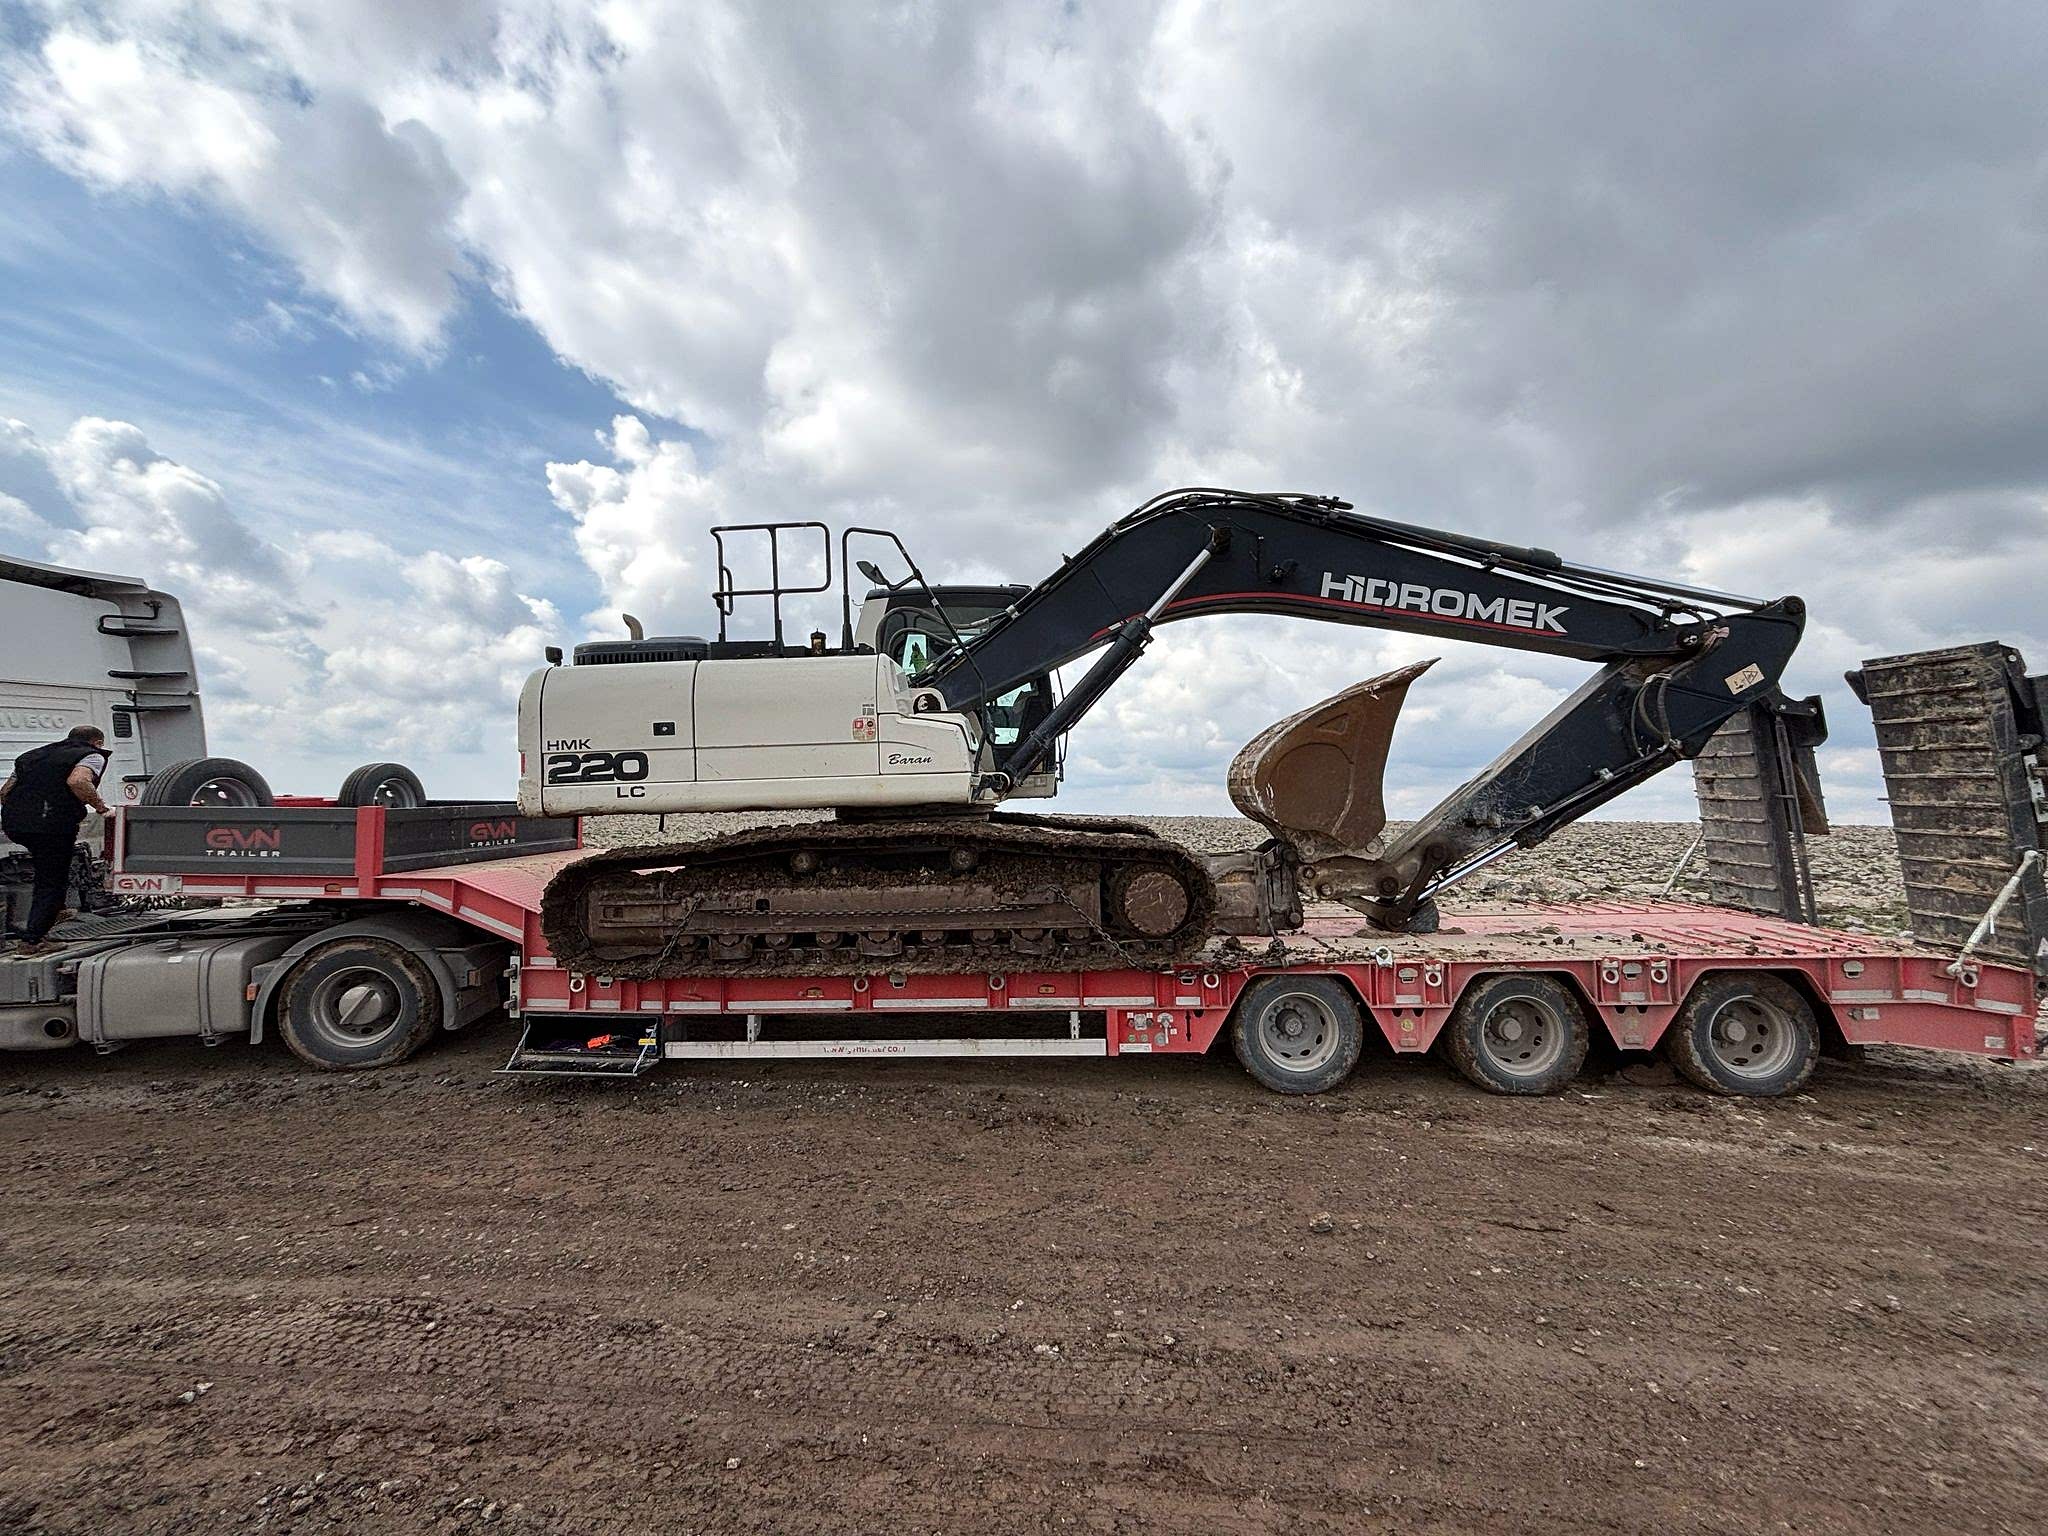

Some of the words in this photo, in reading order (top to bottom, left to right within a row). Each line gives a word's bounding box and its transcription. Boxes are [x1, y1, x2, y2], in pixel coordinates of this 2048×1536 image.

[547, 739, 592, 751] HMK
[887, 753, 933, 765] Baran
[547, 751, 649, 784] 220
[616, 786, 646, 799] LC
[470, 820, 517, 841] GVN
[205, 827, 282, 849] GVN
[470, 838, 517, 848] TRAILER
[205, 850, 282, 858] TRAILER
[118, 878, 163, 891] GVN
